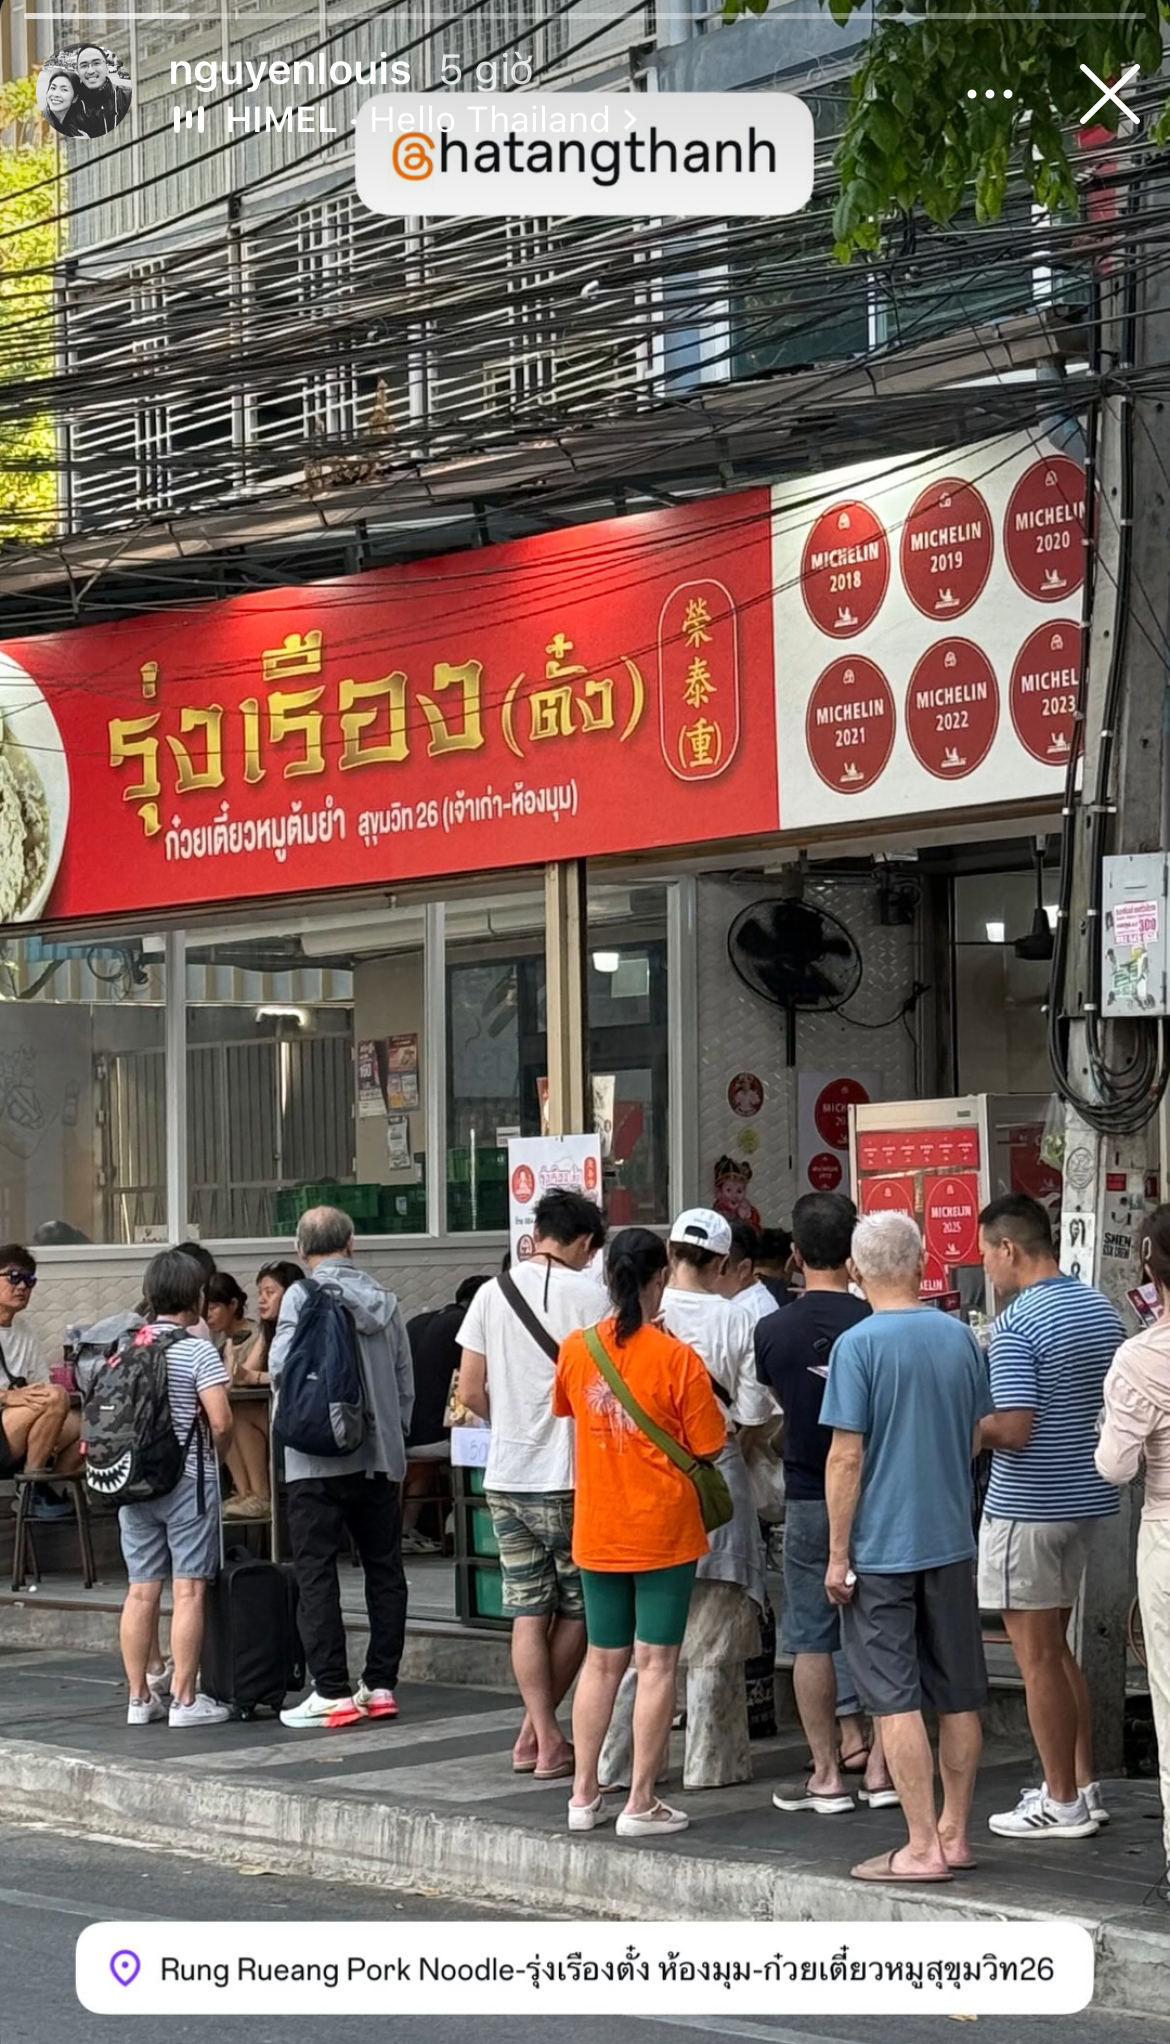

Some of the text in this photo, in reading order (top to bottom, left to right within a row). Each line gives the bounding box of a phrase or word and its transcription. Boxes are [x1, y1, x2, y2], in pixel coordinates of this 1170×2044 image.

[911, 521, 981, 551] MICHELIN
[1036, 530, 1070, 553] 2020
[811, 541, 879, 570] MICHELIN
[930, 551, 963, 573] 2019
[829, 570, 861, 592] 2018
[1021, 667, 1079, 693] MICHEL
[916, 681, 987, 709] MICHELIN
[1041, 694, 1076, 716] 2023
[816, 698, 884, 726] MICHELIN
[935, 710, 969, 731] 2022
[108, 629, 485, 837] รุ่งเรือง
[835, 727, 865, 747] 2021
[165, 794, 346, 863] ก๋วยเตี๋ยวหมูต้มยำ
[822, 1103, 848, 1113] MICH
[930, 1205, 972, 1218] MICHELIN
[920, 1278, 943, 1292] ELIN
